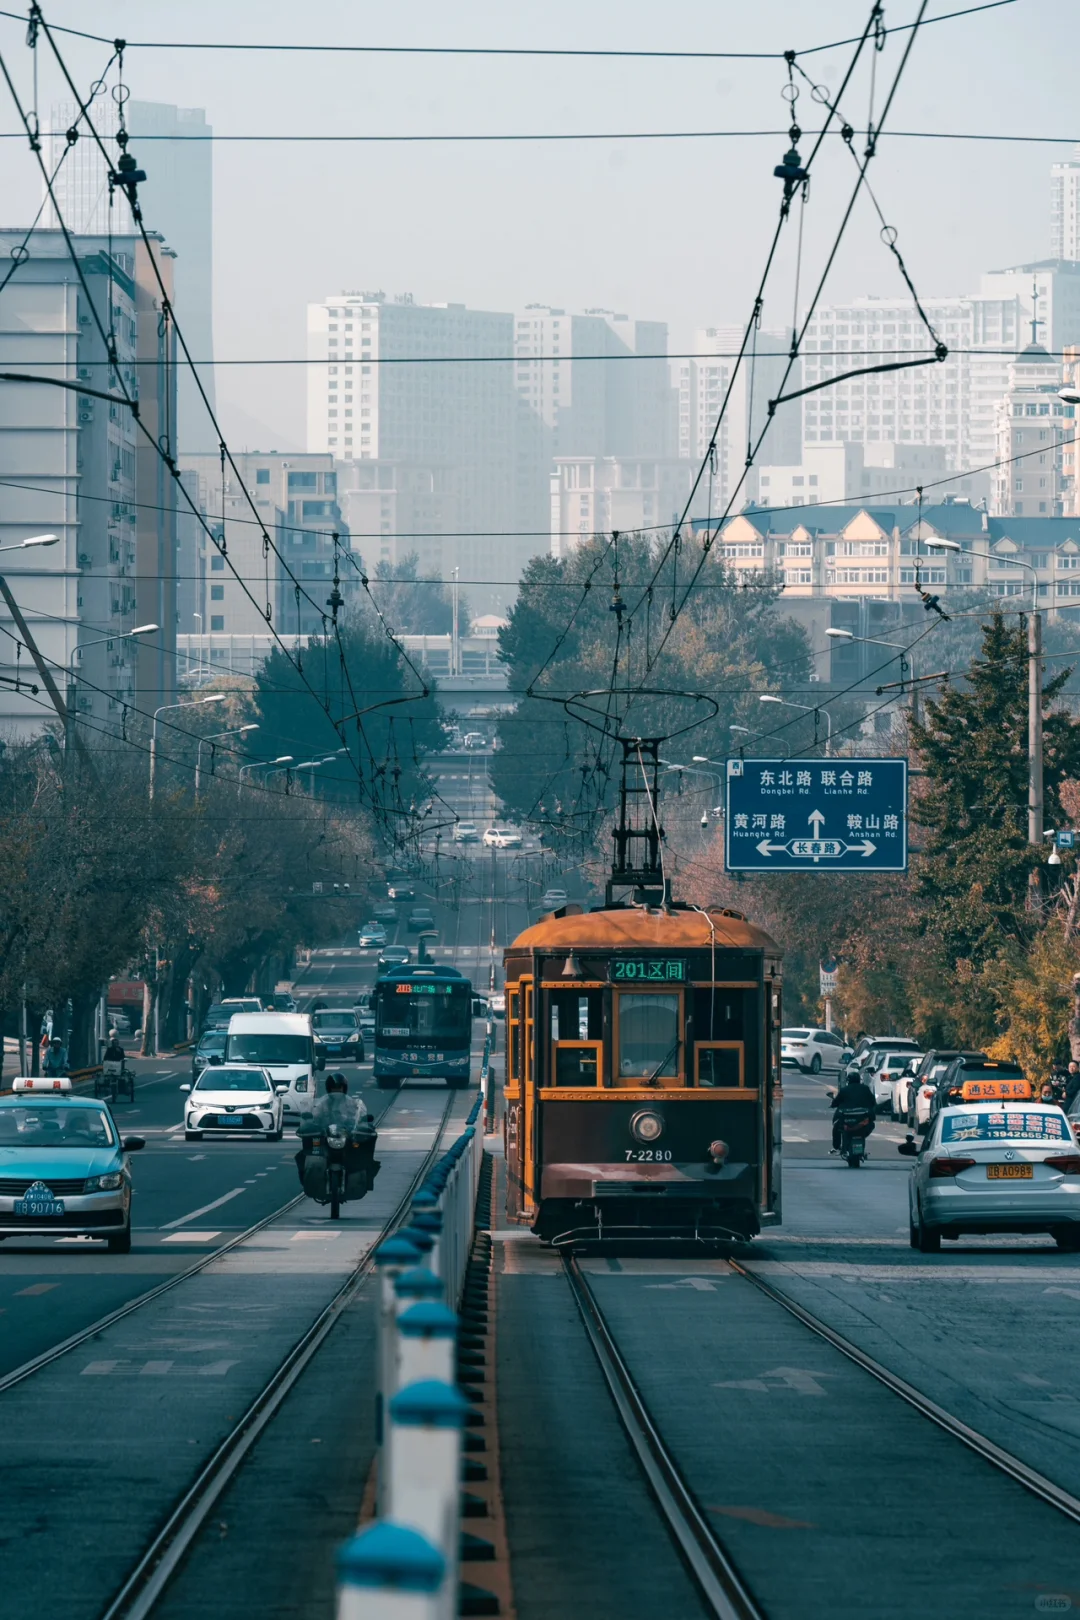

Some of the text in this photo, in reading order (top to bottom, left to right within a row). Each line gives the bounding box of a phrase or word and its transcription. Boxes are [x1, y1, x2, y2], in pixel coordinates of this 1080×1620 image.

[759, 769, 873, 787] 东北路 联合路
[760, 787, 870, 796] Dongbei Rd. Lianhe Rd.
[733, 813, 787, 830] 黄河路
[846, 813, 899, 830] 鞍山路
[732, 830, 770, 839] Huanghe
[796, 842, 836, 854] 长春路
[615, 961, 683, 979] 201区间
[967, 1083, 1025, 1096] 通达驾校
[624, 1149, 672, 1161] 7-2280
